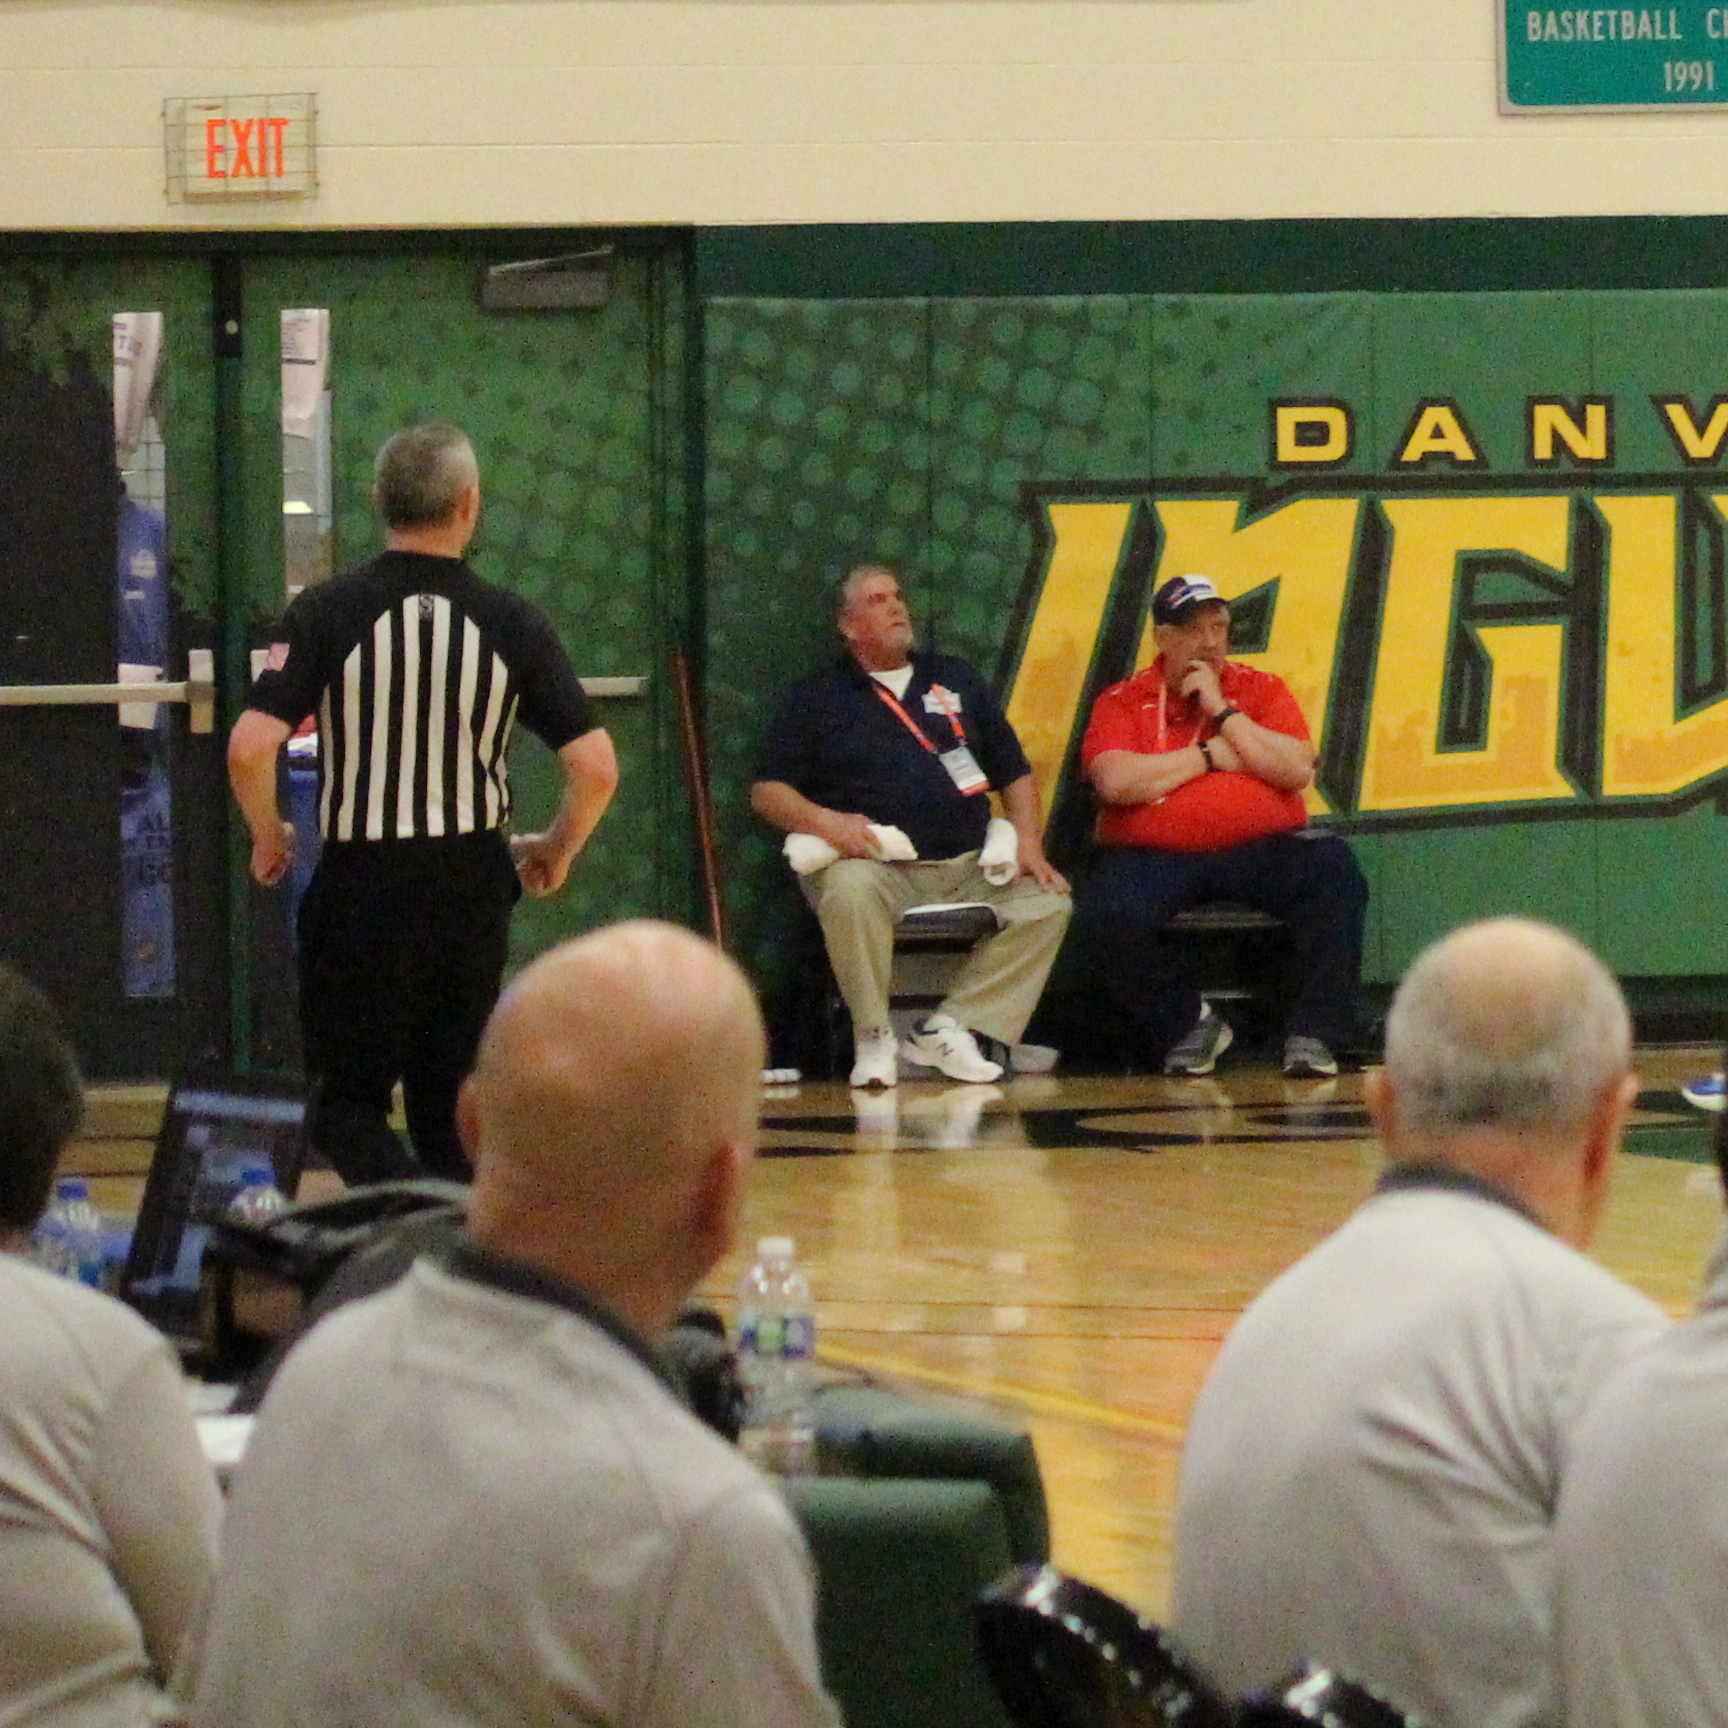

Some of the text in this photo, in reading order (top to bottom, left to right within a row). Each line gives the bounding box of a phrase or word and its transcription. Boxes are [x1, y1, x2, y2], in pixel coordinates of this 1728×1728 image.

[1528, 10, 1682, 41] BASKETBALL
[1664, 61, 1714, 91] 1991
[205, 118, 289, 178] EXIT
